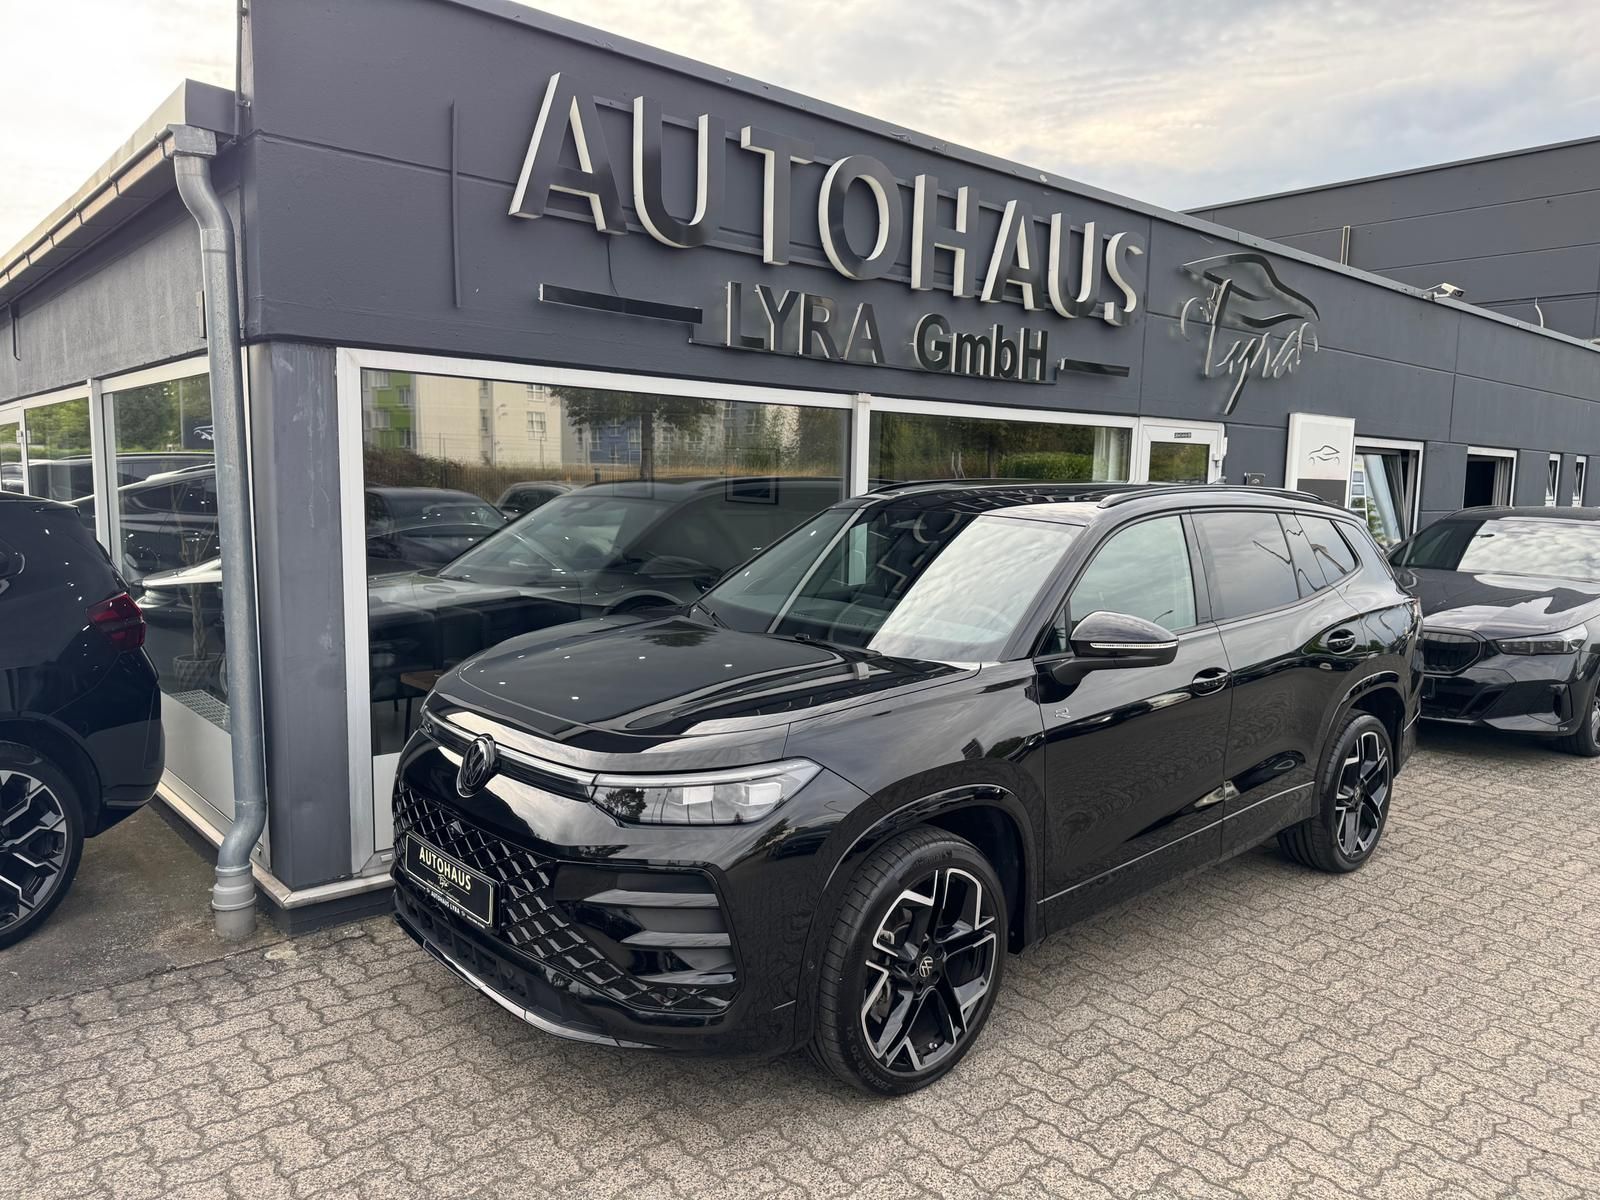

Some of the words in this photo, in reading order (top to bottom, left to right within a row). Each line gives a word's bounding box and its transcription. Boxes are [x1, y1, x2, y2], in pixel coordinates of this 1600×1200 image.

[508, 72, 1146, 327] AUTOHAUS
[727, 281, 885, 364] LYRA
[913, 313, 1048, 380] GmbH
[419, 846, 472, 891] AUTOHAUS
